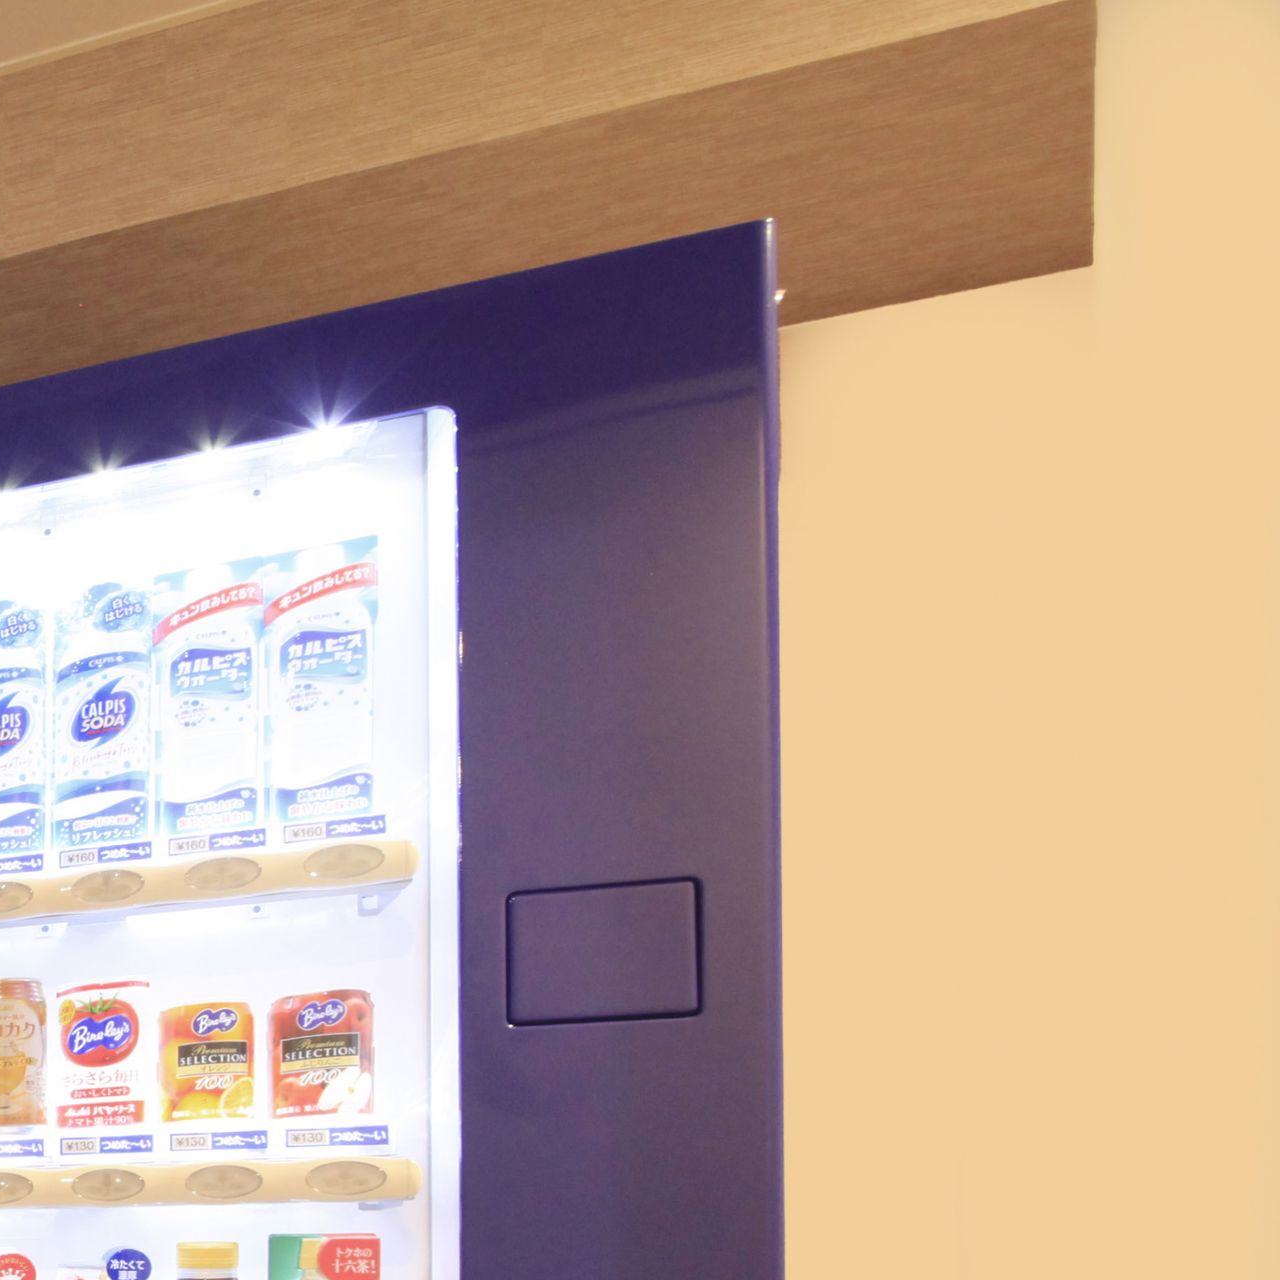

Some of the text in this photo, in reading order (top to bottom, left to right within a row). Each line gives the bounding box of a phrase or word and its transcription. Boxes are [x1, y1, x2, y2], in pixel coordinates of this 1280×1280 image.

[105, 603, 144, 623] はじける
[0, 620, 38, 639] はじける
[287, 632, 363, 658] カルピス
[176, 650, 251, 677] カルピス
[286, 650, 363, 672] ウォーター
[176, 668, 248, 689] ウォーター
[81, 697, 127, 720] CALPIS
[80, 714, 127, 733] SODA
[292, 826, 323, 839] ¥160
[176, 839, 206, 851] ¥160
[180, 1053, 247, 1066] SELECTION
[284, 1046, 358, 1063] SELECTION
[175, 1137, 206, 1148] ¥130
[291, 1132, 324, 1144] ¥130
[66, 1141, 95, 1152] ¥130
[335, 1248, 373, 1259] トクホの
[110, 1259, 145, 1271] 冷たくて
[331, 1260, 377, 1275] 十六茶!
